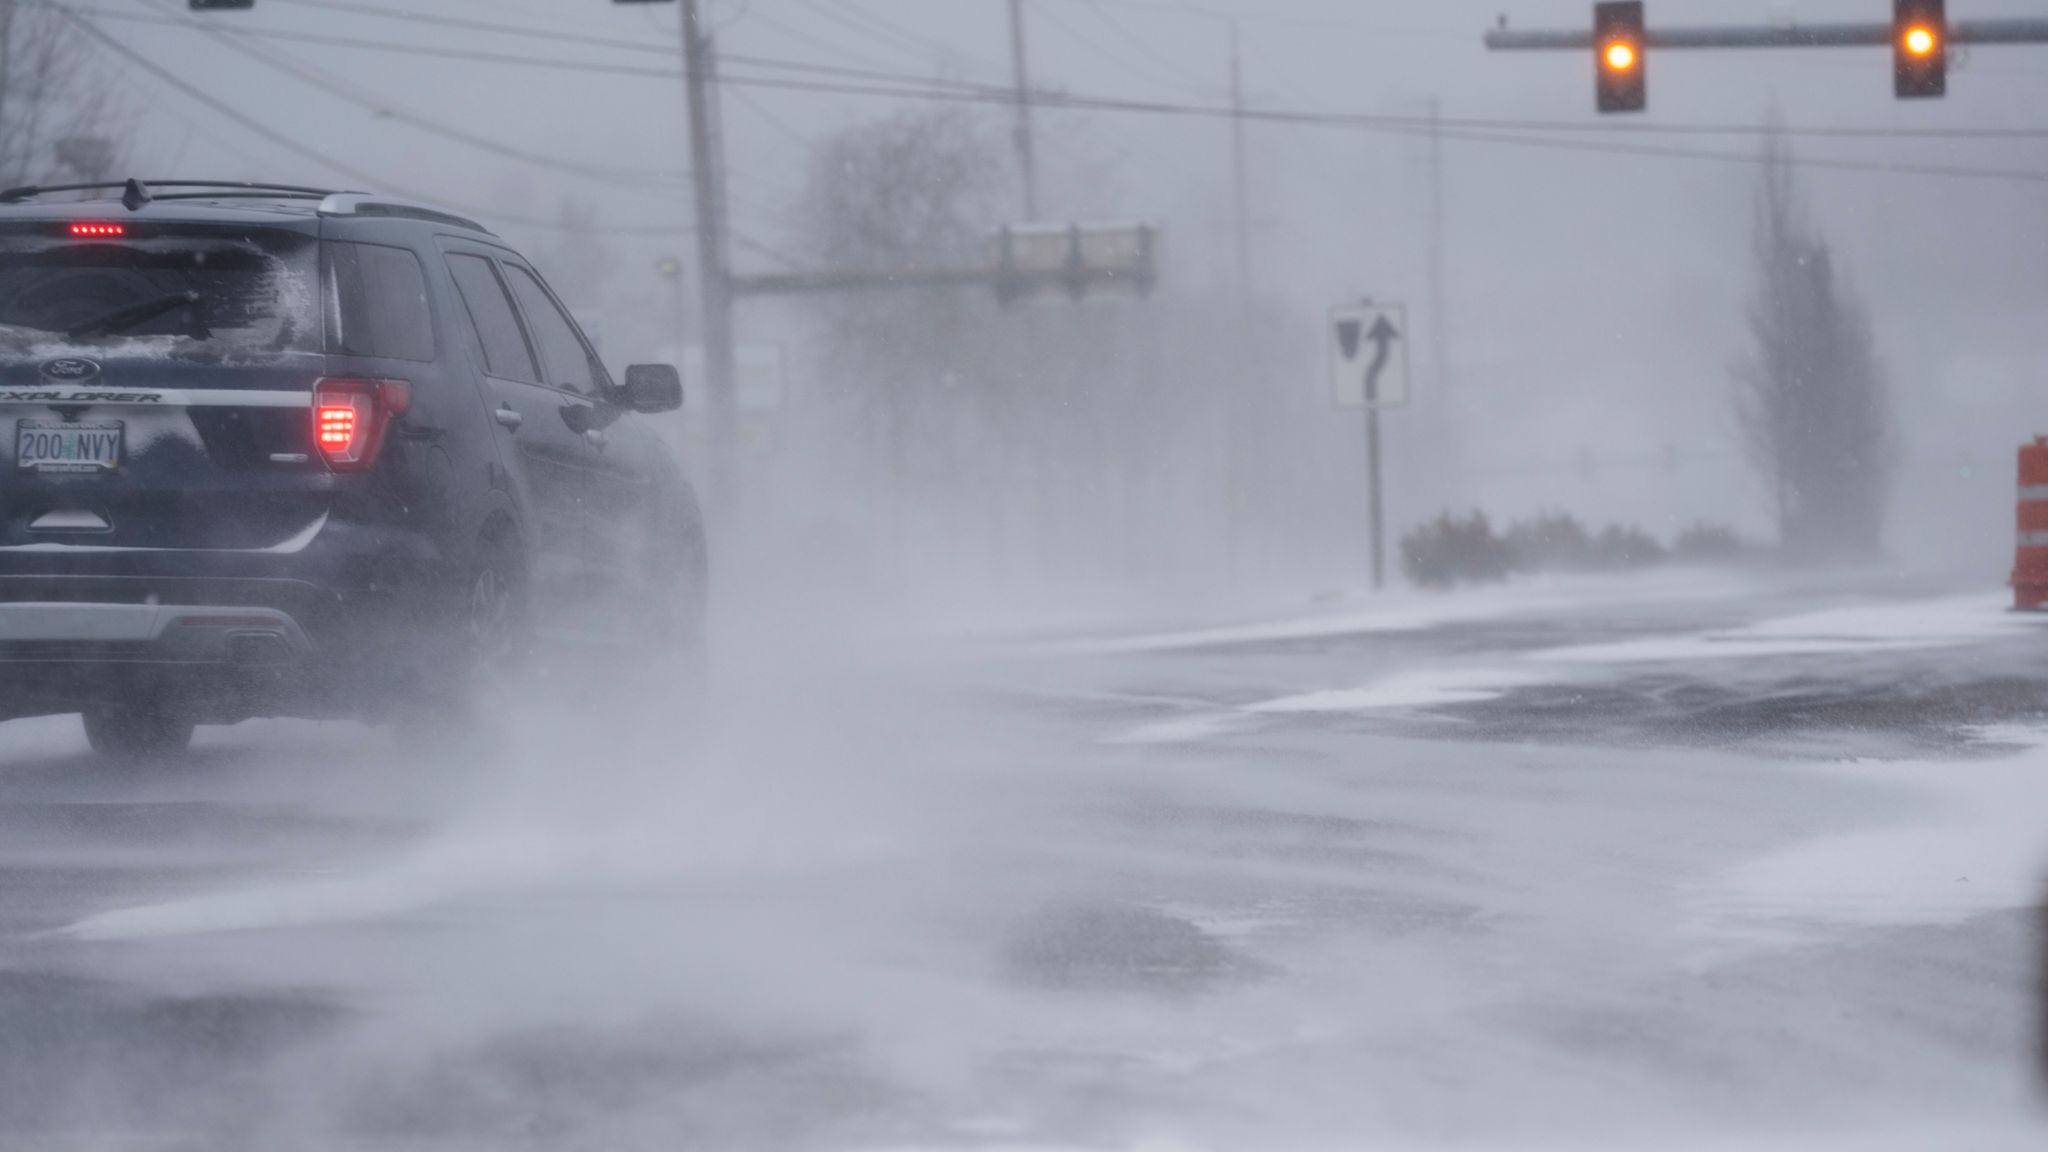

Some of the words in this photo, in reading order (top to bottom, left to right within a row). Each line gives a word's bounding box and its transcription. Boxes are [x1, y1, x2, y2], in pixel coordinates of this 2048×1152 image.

[51, 360, 86, 374] Ford
[22, 433, 62, 459] 200
[78, 433, 117, 460] NVY
